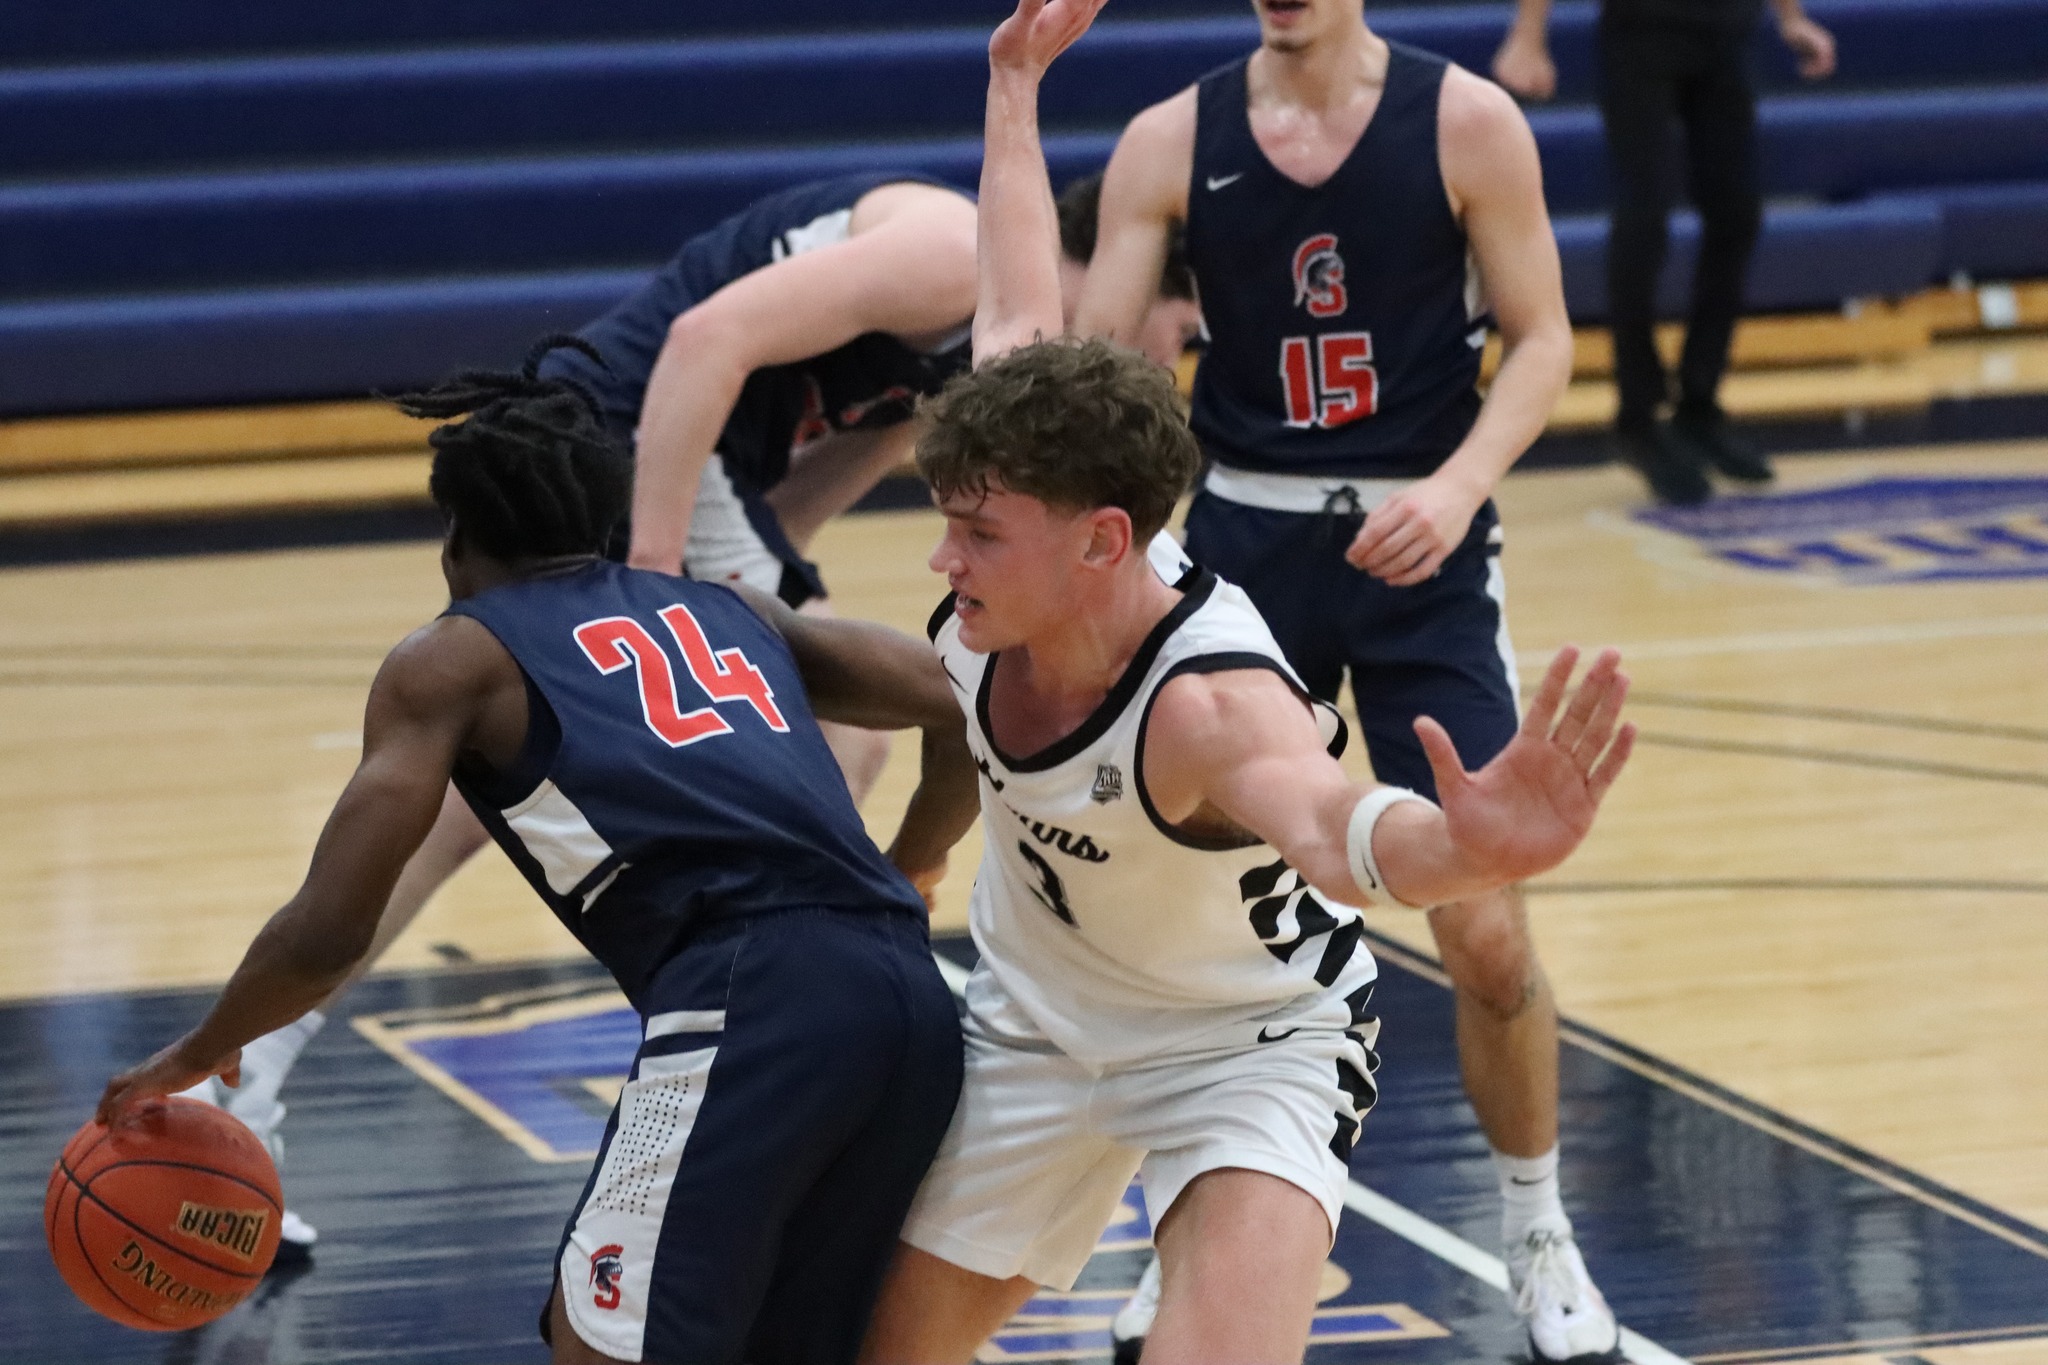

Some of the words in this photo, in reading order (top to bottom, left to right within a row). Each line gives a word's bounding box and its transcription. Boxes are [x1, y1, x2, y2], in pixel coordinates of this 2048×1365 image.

[1280, 331, 1379, 429] 15
[572, 603, 790, 748] 24
[181, 1207, 265, 1257] NJCAA
[112, 1240, 243, 1312] LDING
